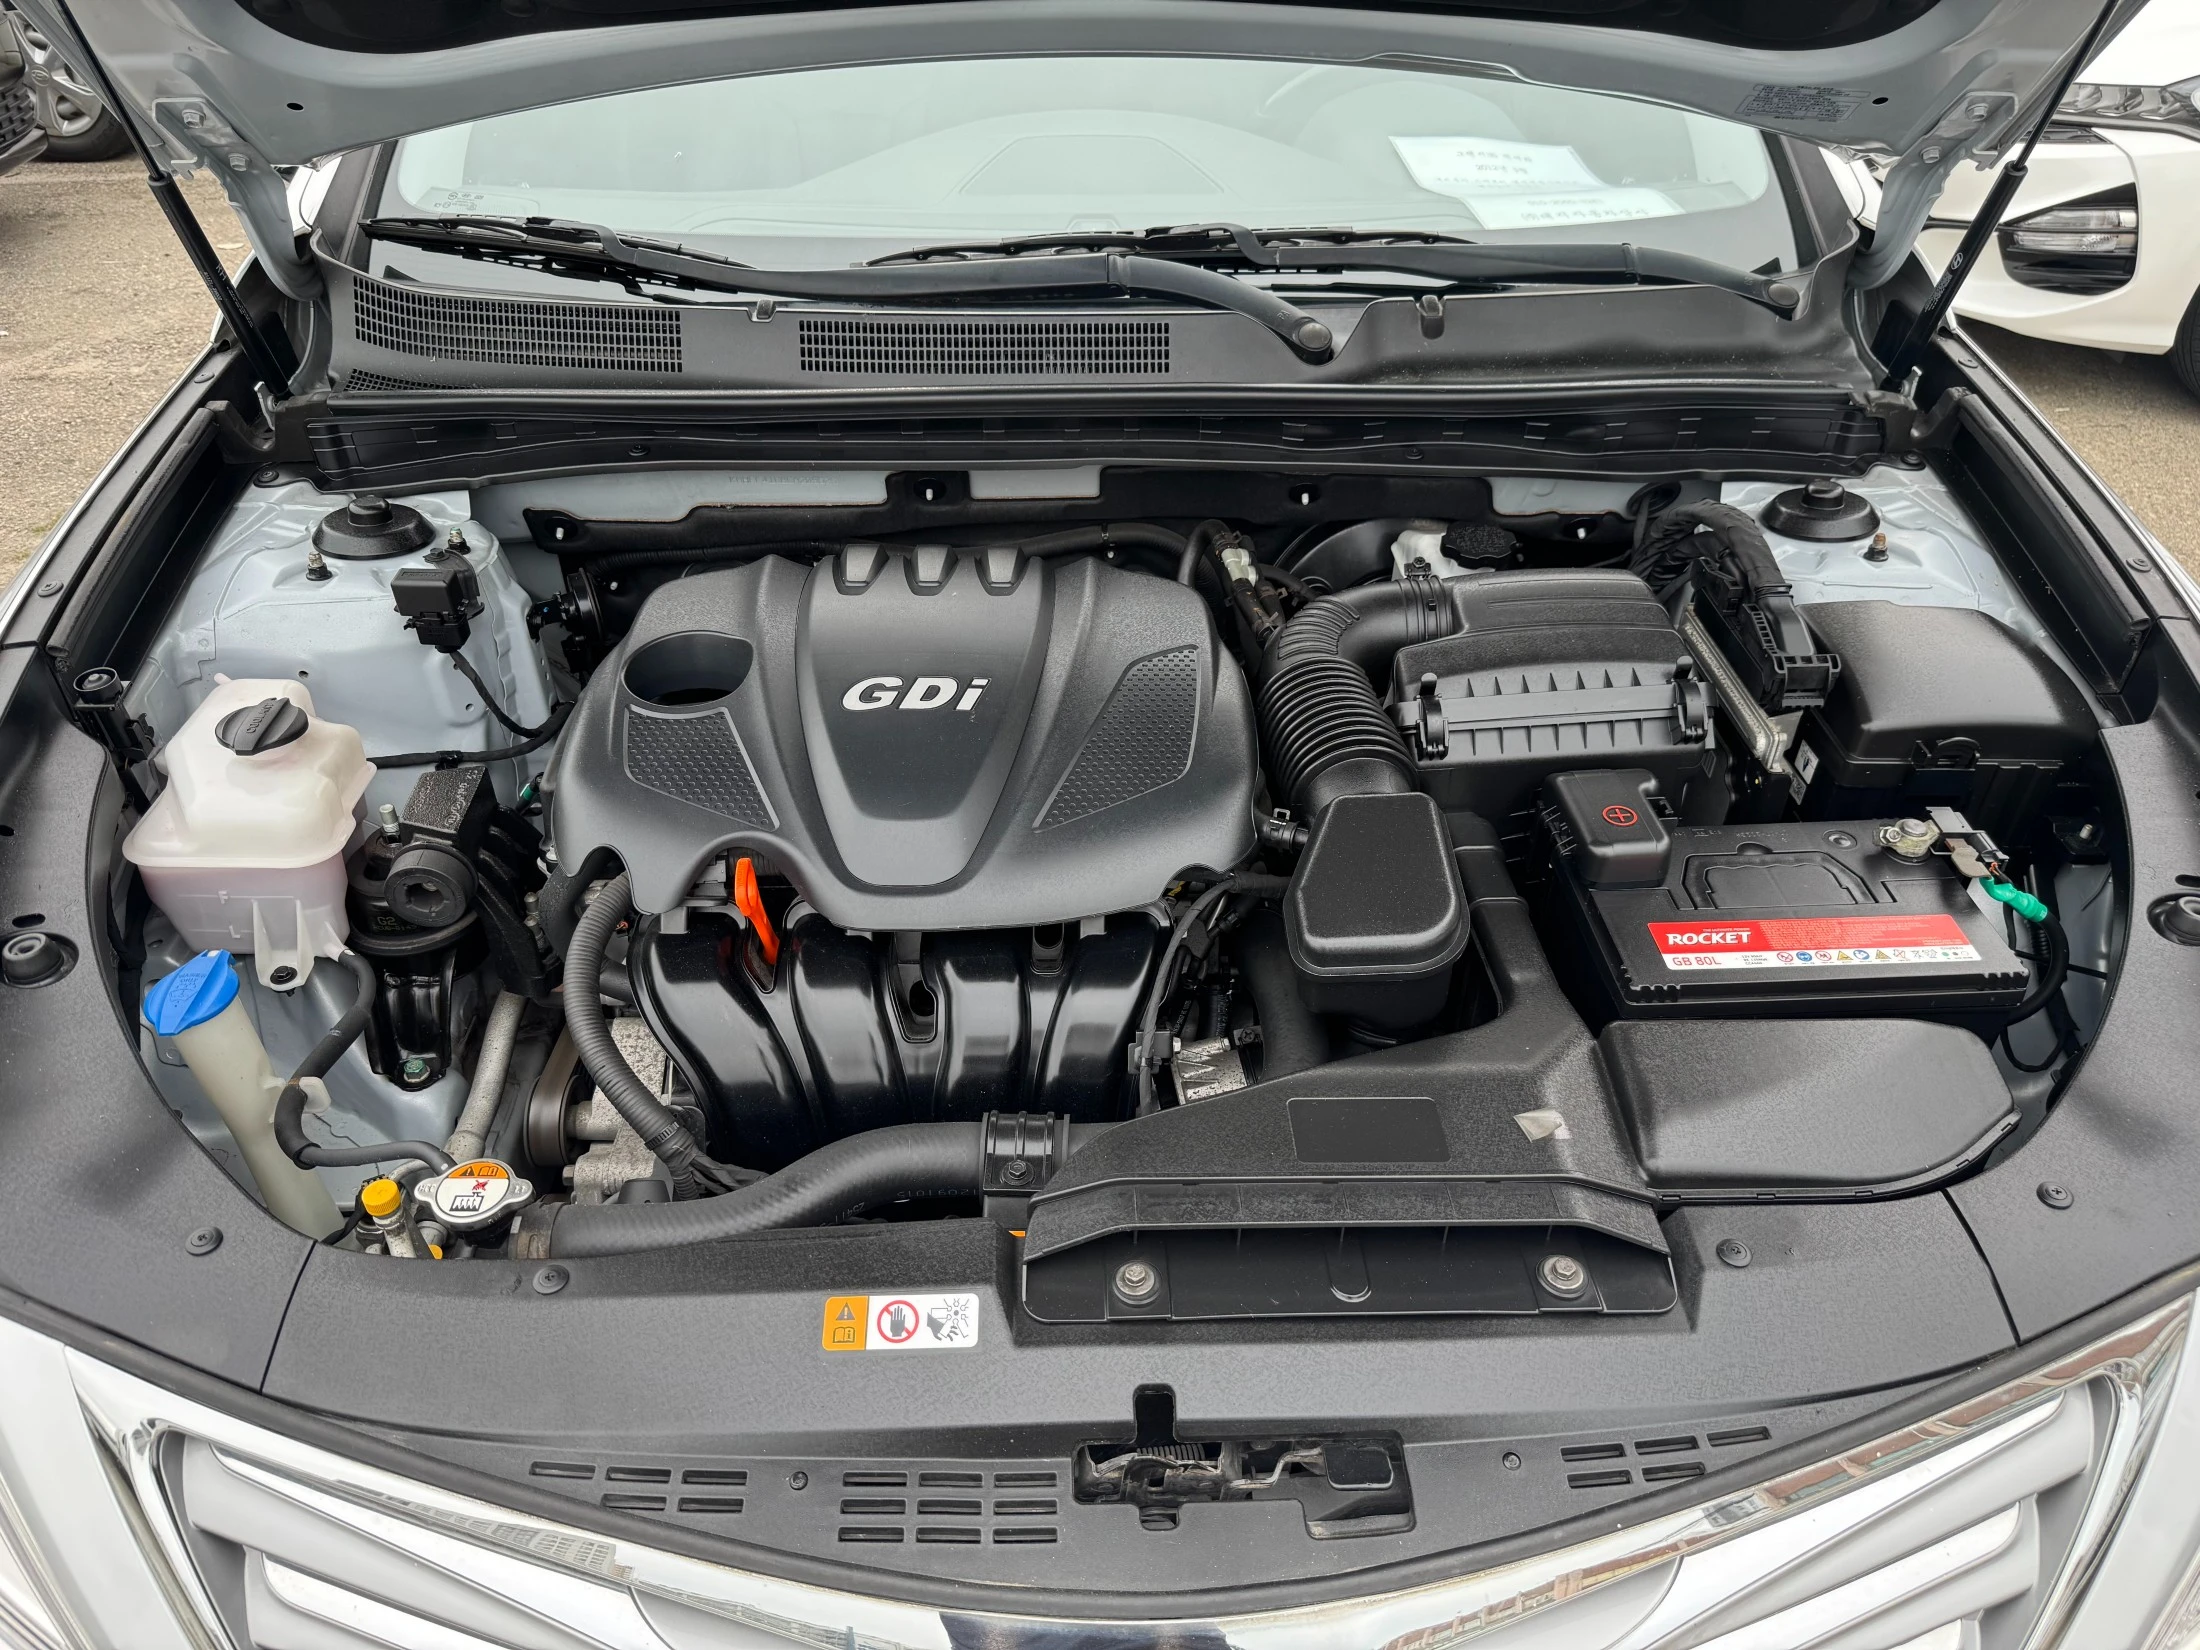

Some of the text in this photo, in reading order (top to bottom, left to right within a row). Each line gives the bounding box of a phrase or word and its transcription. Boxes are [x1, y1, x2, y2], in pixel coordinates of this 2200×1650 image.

[841, 676, 991, 711] GDi
[218, 890, 229, 904] F
[229, 925, 241, 939] L
[1666, 931, 1751, 945] ROCKET
[1672, 956, 1721, 966] GB 80L
